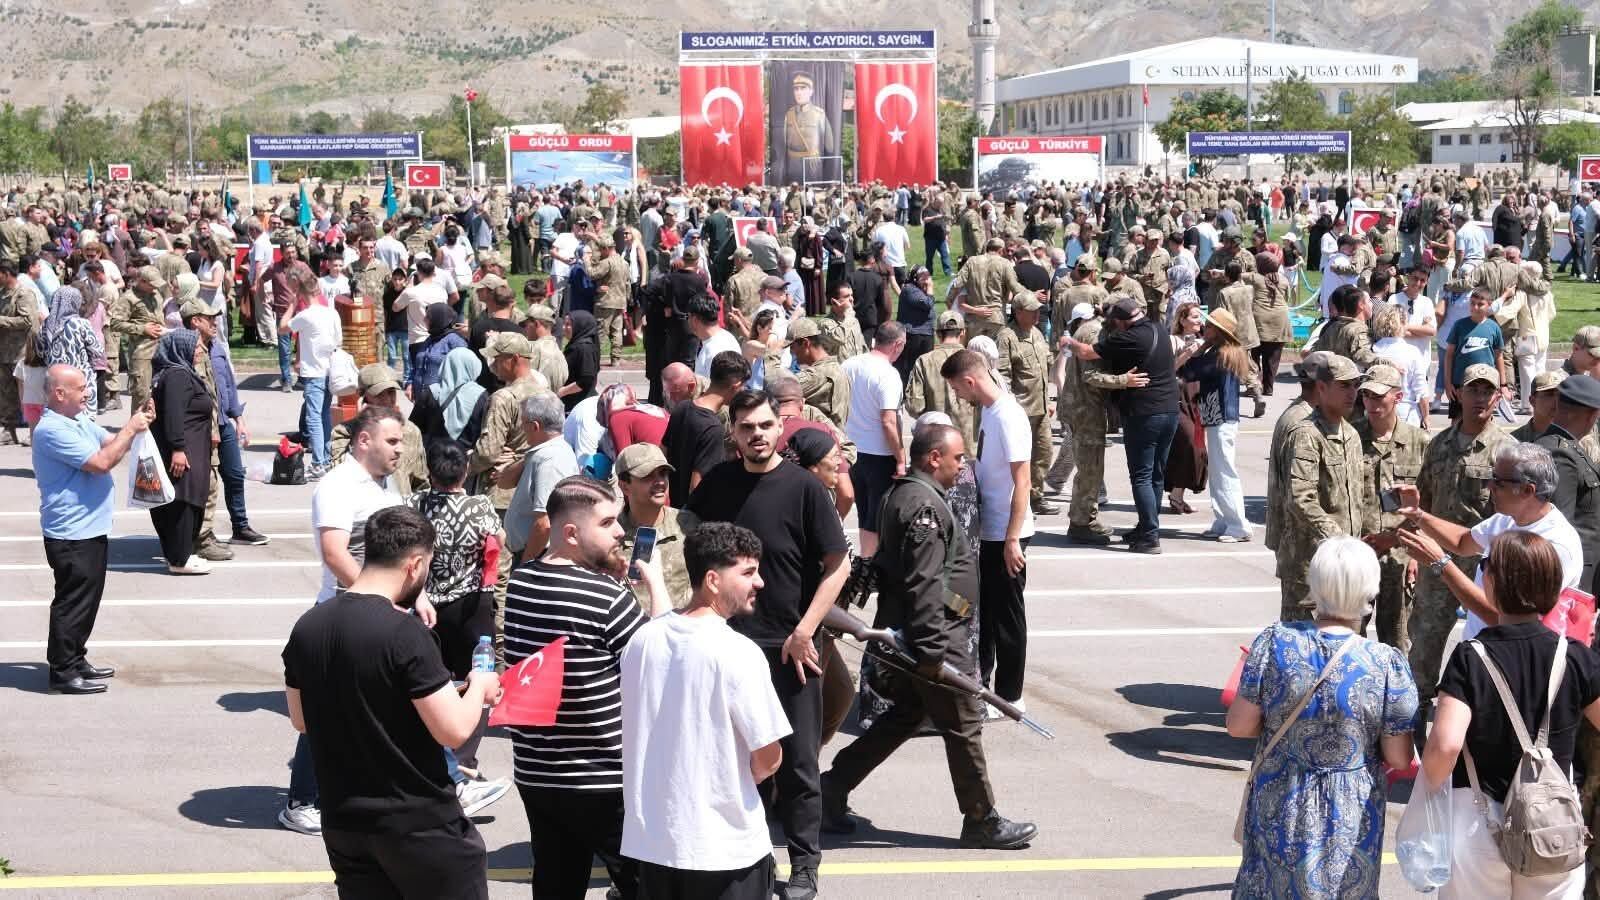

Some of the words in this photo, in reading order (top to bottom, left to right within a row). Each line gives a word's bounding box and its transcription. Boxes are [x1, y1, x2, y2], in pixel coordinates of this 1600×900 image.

[691, 36, 769, 47] SLOGANIMIZ:
[771, 34, 810, 47] ETKİN,
[813, 35, 875, 47] CAYDIRICI,
[878, 34, 925, 45] SAYGIN.
[1171, 65, 1220, 77] SULTAN
[1301, 64, 1339, 77] TUGAY
[529, 137, 569, 149] GÜÇLÜ
[578, 138, 612, 147] ORDU
[990, 140, 1030, 151] GÜÇLÜ
[1039, 139, 1089, 150] TÜRKİYE
